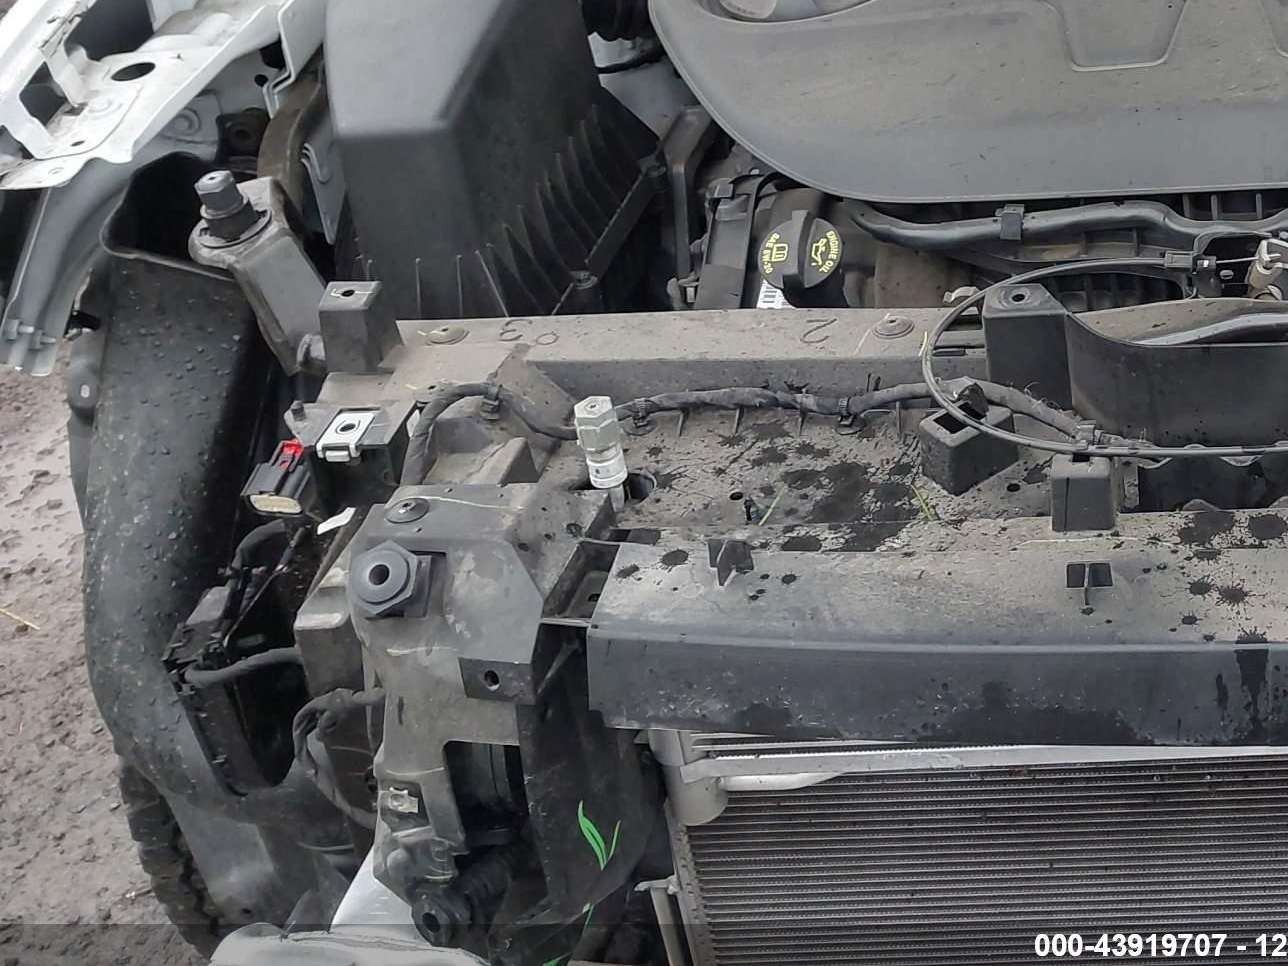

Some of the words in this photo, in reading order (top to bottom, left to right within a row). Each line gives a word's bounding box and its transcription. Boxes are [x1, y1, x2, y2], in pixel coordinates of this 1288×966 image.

[765, 232, 781, 249] SAE
[825, 230, 840, 260] ENGINE
[818, 260, 835, 274] OIL
